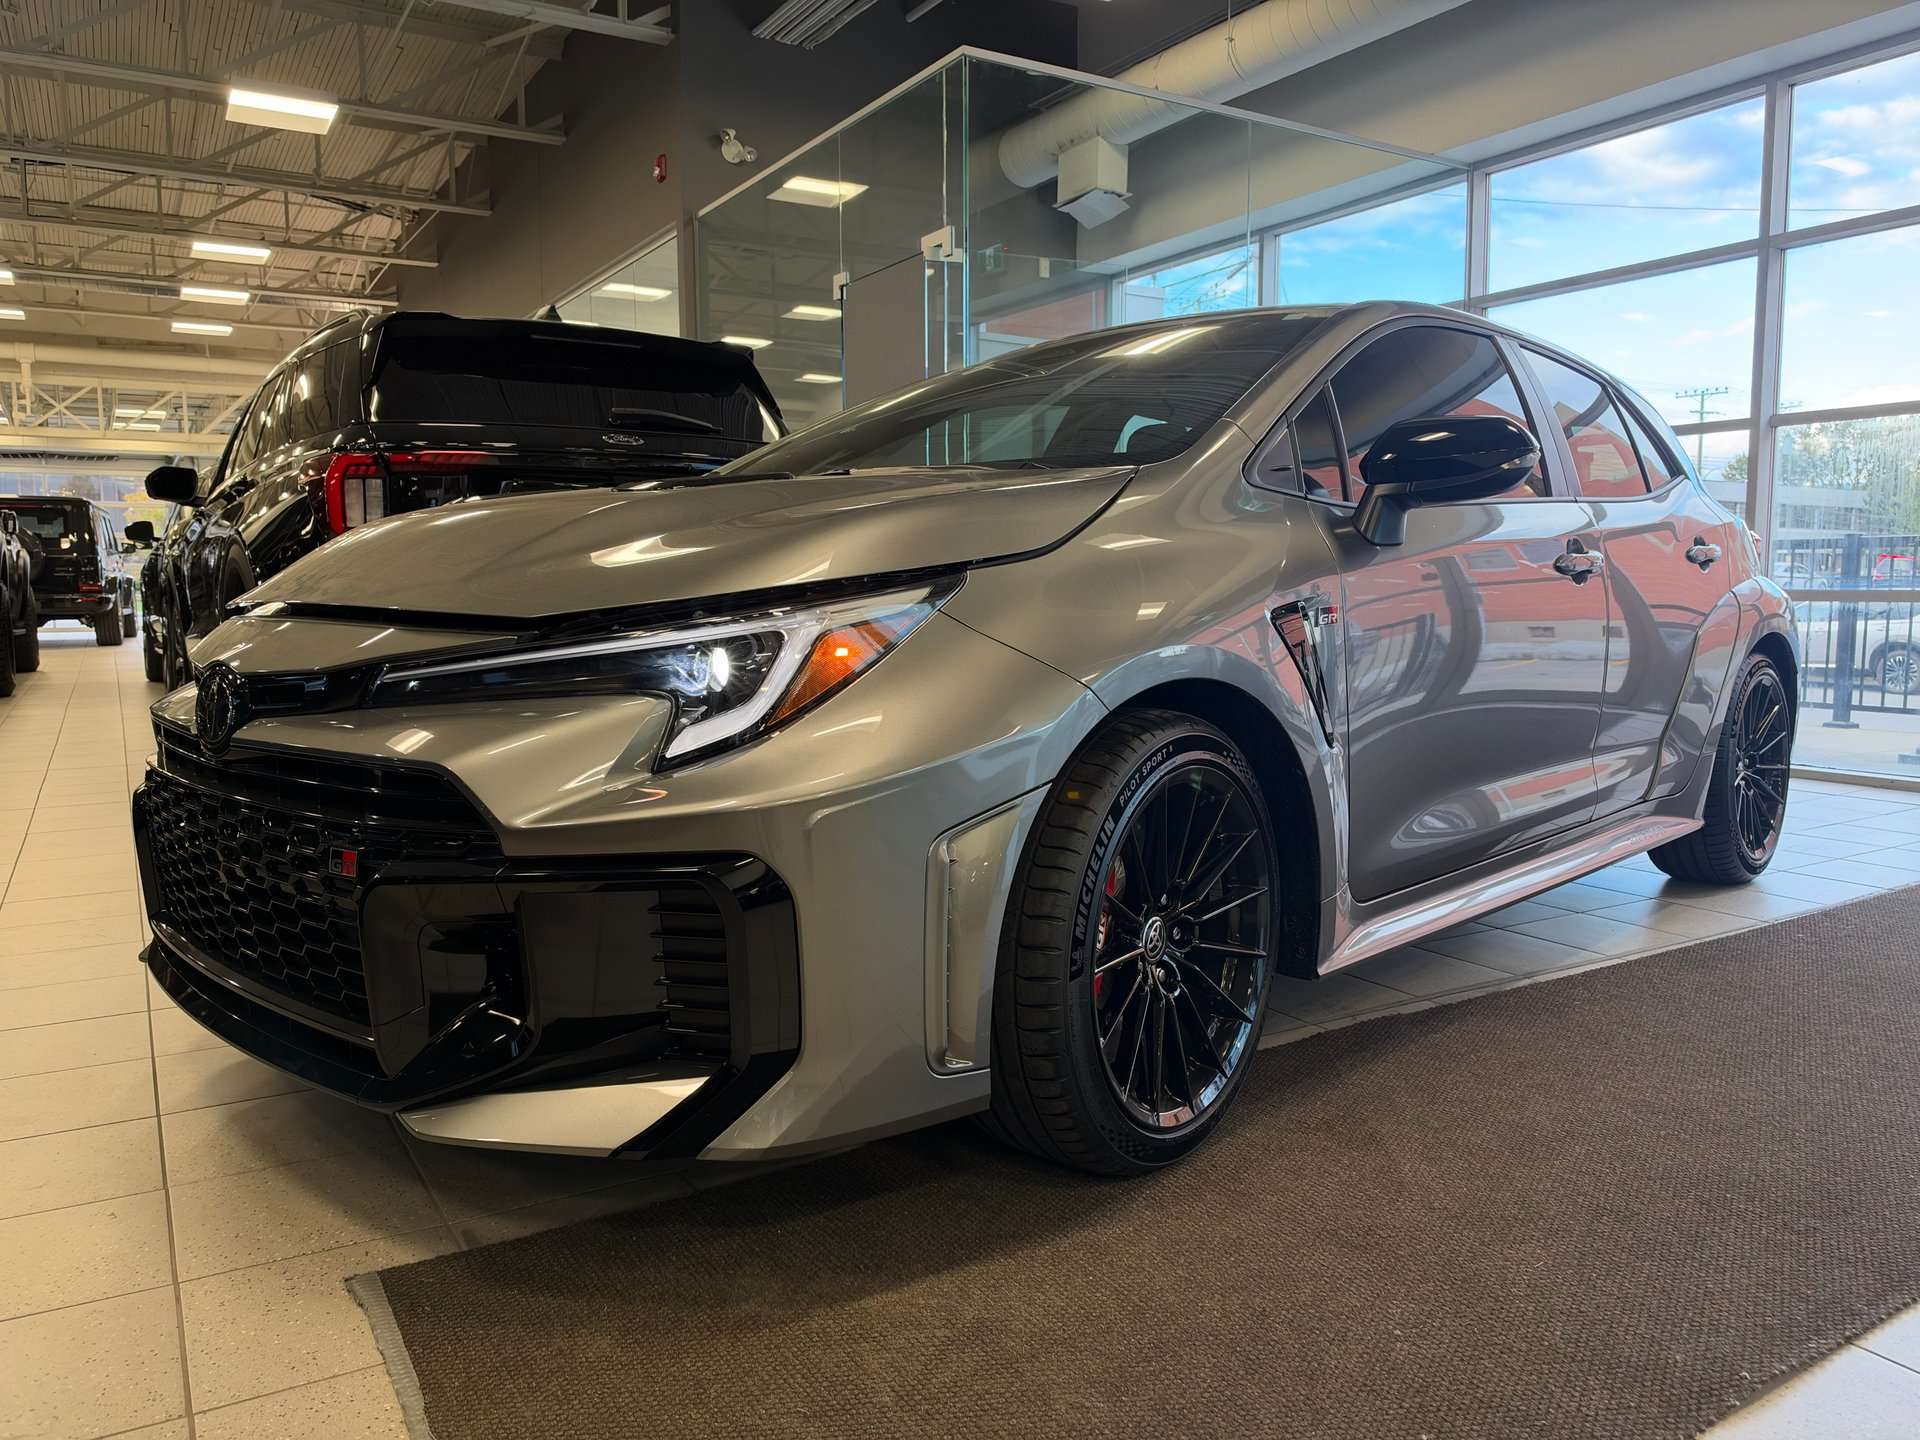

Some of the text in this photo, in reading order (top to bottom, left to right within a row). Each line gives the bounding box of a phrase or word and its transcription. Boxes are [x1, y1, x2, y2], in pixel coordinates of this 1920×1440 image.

[1320, 613, 1337, 625] GR
[1075, 749, 1169, 941] MICHELIN PILOT SPORT
[332, 859, 354, 875] GR
